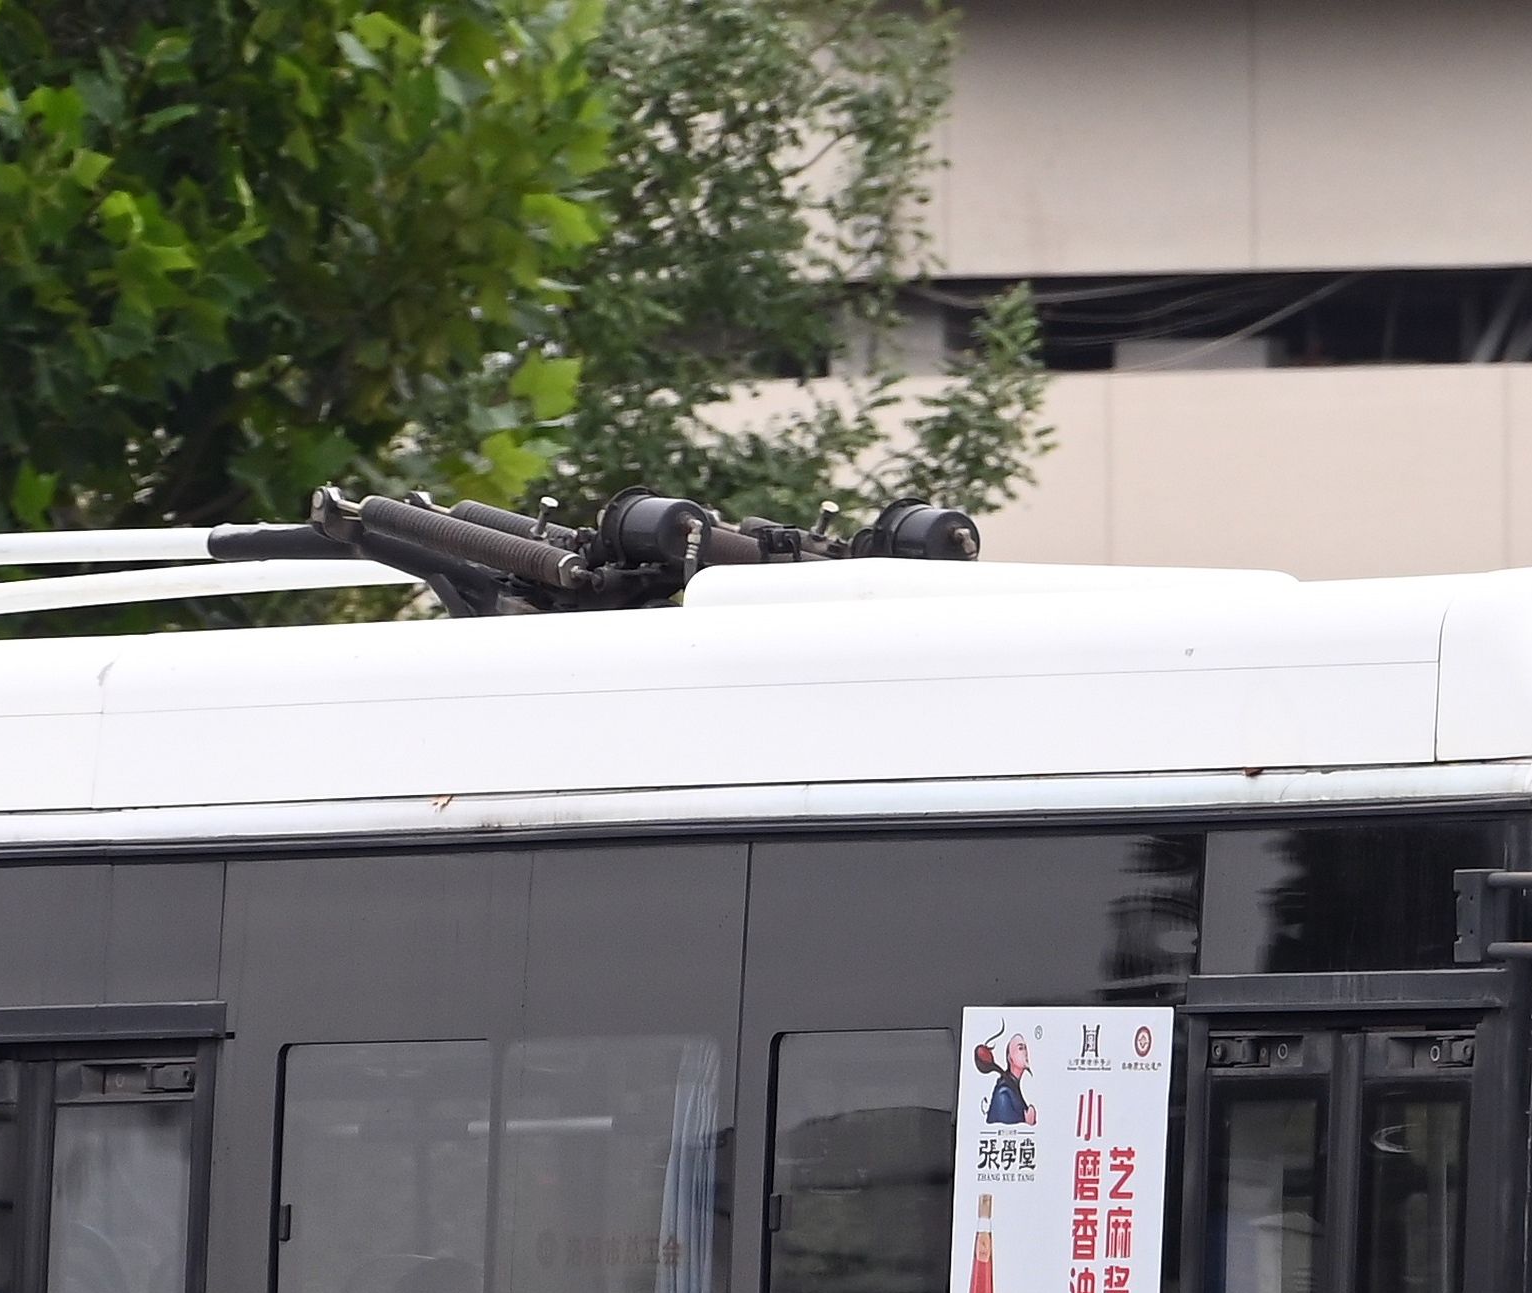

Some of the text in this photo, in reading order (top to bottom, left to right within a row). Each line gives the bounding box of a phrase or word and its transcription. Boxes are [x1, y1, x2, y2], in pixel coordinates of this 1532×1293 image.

[977, 1137, 1036, 1171] 張學堂
[977, 1173, 1034, 1182] ZHANG XUE TANG
